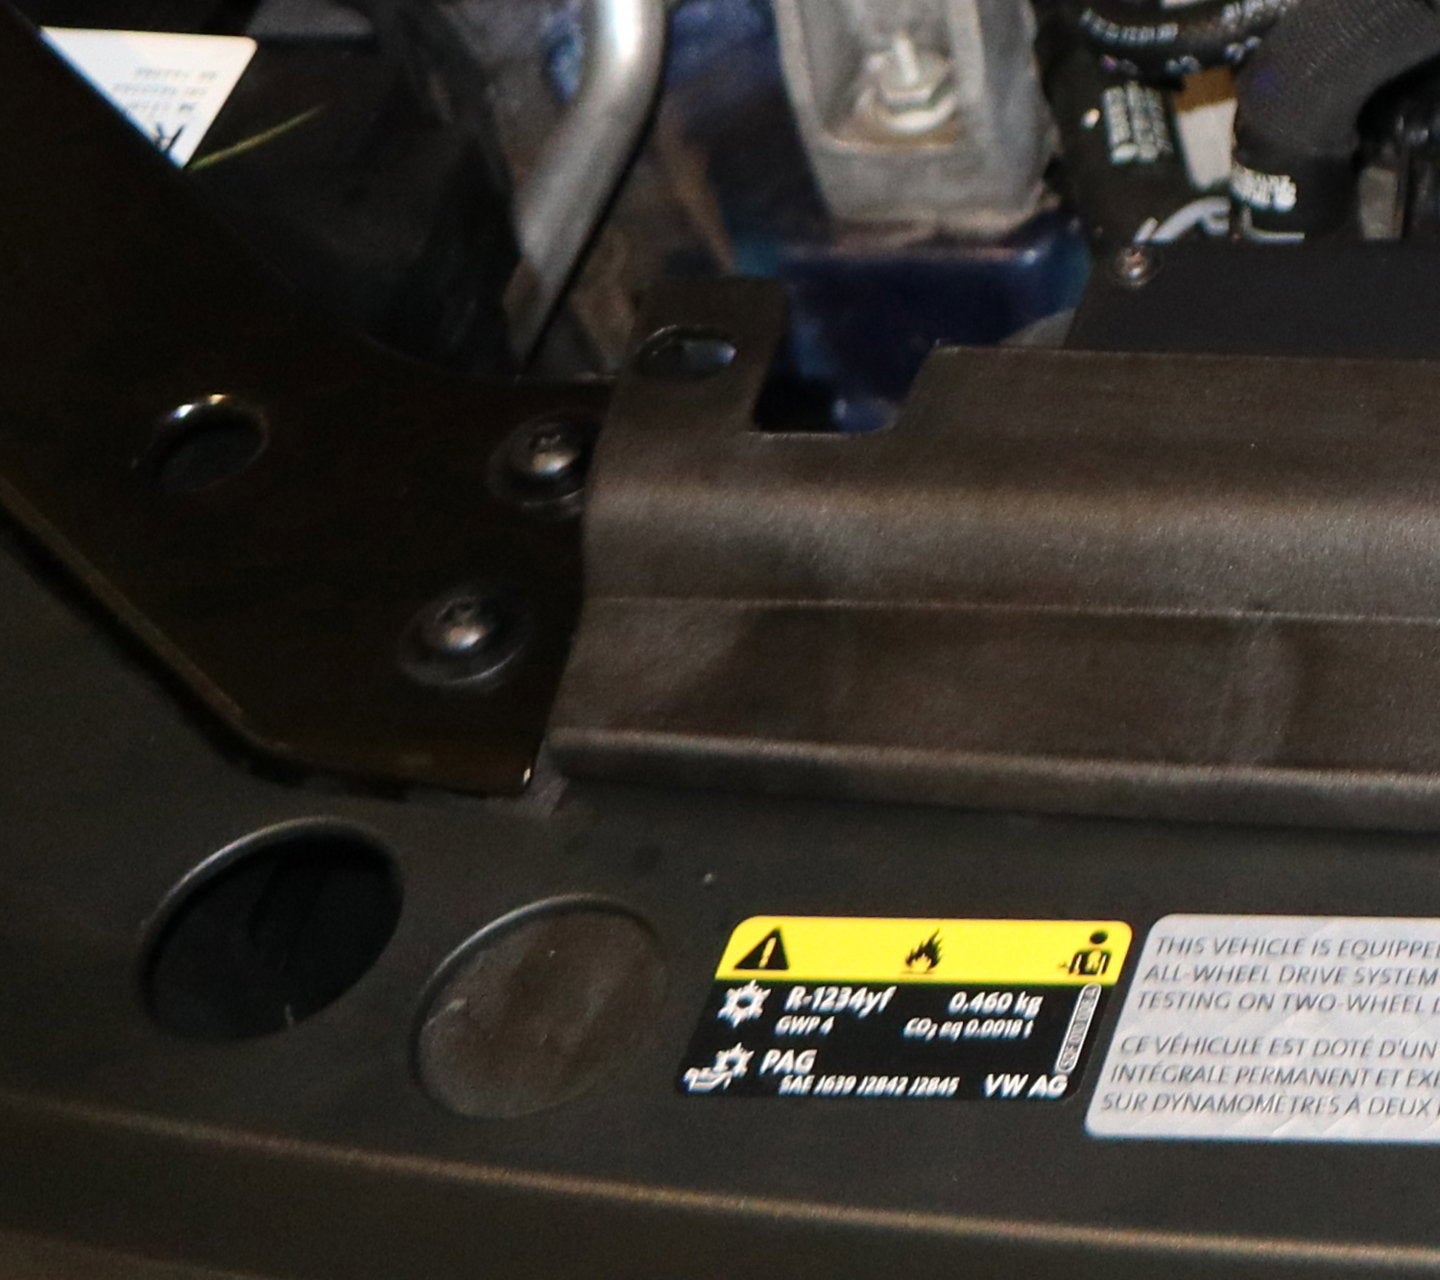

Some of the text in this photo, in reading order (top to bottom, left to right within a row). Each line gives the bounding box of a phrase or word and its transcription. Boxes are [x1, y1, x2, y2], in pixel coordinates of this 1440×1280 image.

[1156, 936, 1204, 956] THIS
[1212, 936, 1308, 956] VEHICLE
[1310, 939, 1330, 956] IS
[1142, 963, 1272, 983] ALL-WHEEL
[1277, 965, 1347, 985] DRIVE
[1354, 967, 1439, 987] SYSTEM
[782, 985, 897, 1018] R-1234yf
[947, 990, 1043, 1019] 0.460 kg
[1137, 991, 1230, 1010] TESTING
[1236, 993, 1275, 1012] ON
[1281, 993, 1426, 1014] TWO-WHEEL
[774, 1014, 834, 1035] GWP 4
[759, 1048, 817, 1076] PAG
[984, 1072, 1068, 1098] VW AG
